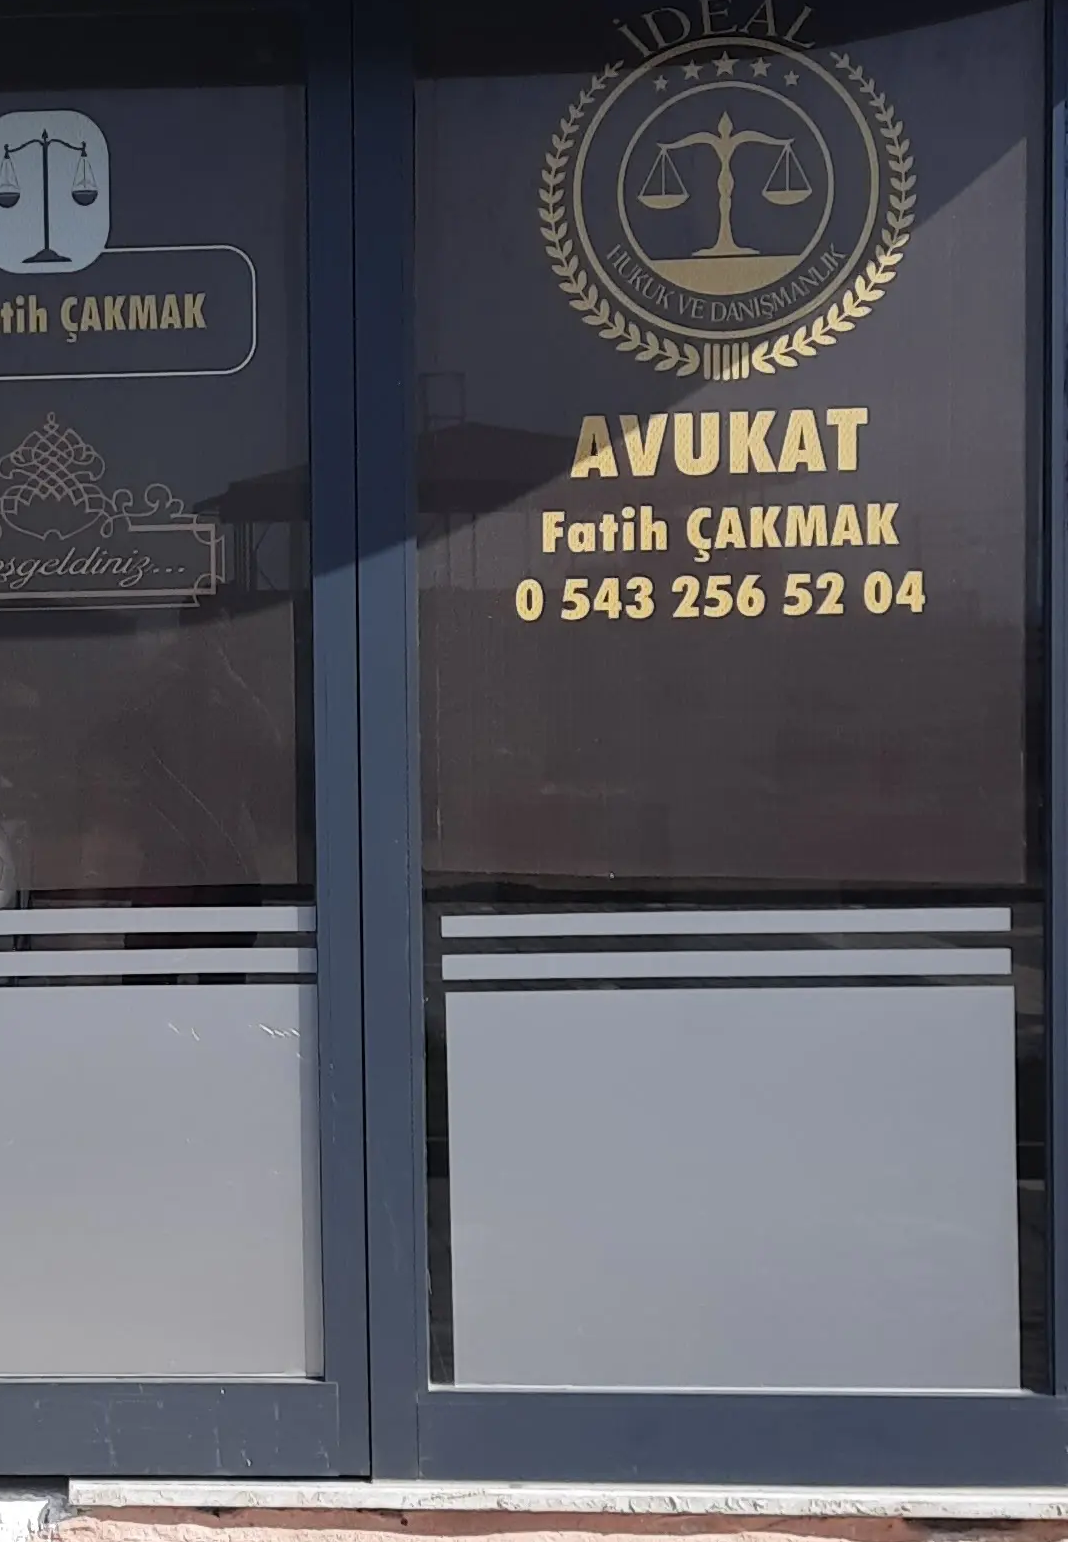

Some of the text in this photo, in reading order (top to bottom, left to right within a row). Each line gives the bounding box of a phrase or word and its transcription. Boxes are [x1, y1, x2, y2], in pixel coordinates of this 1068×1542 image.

[605, 242, 849, 322] HUKUK VE DANIŞMANLIK
[60, 292, 208, 344] ÇAKMAK
[569, 406, 869, 479] AVUKAT
[540, 501, 900, 562] Fatih ÇAKMAK
[514, 569, 926, 621] 0 543 256 52 04
